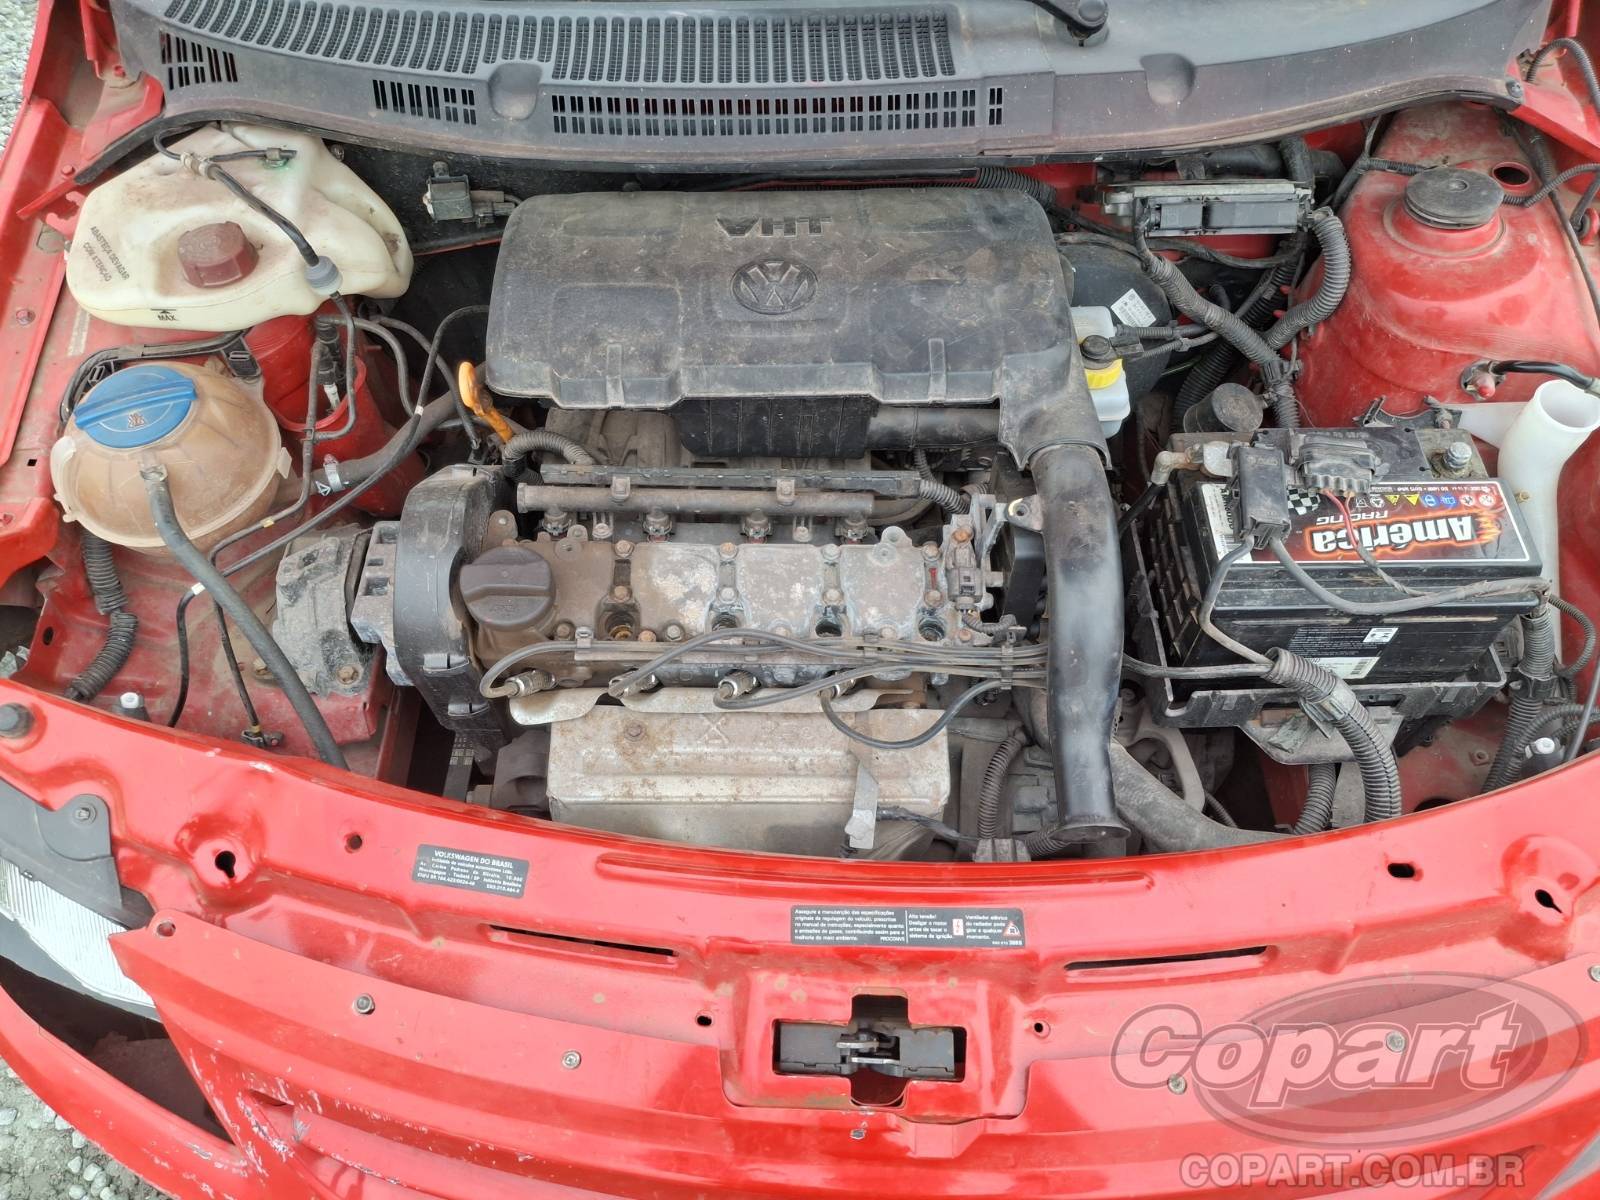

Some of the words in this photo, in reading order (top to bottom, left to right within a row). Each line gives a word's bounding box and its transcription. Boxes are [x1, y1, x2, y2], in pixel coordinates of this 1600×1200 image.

[715, 215, 833, 238] VHT
[83, 242, 96, 257] COM
[90, 226, 113, 255] ABASTEÇA
[108, 253, 130, 280] DEVAGAR
[1316, 510, 1388, 526] RACNG
[1312, 516, 1473, 552] América
[434, 850, 480, 863] VOLKSWAGEN
[480, 857, 490, 865] DO
[492, 859, 513, 869] BRASIL
